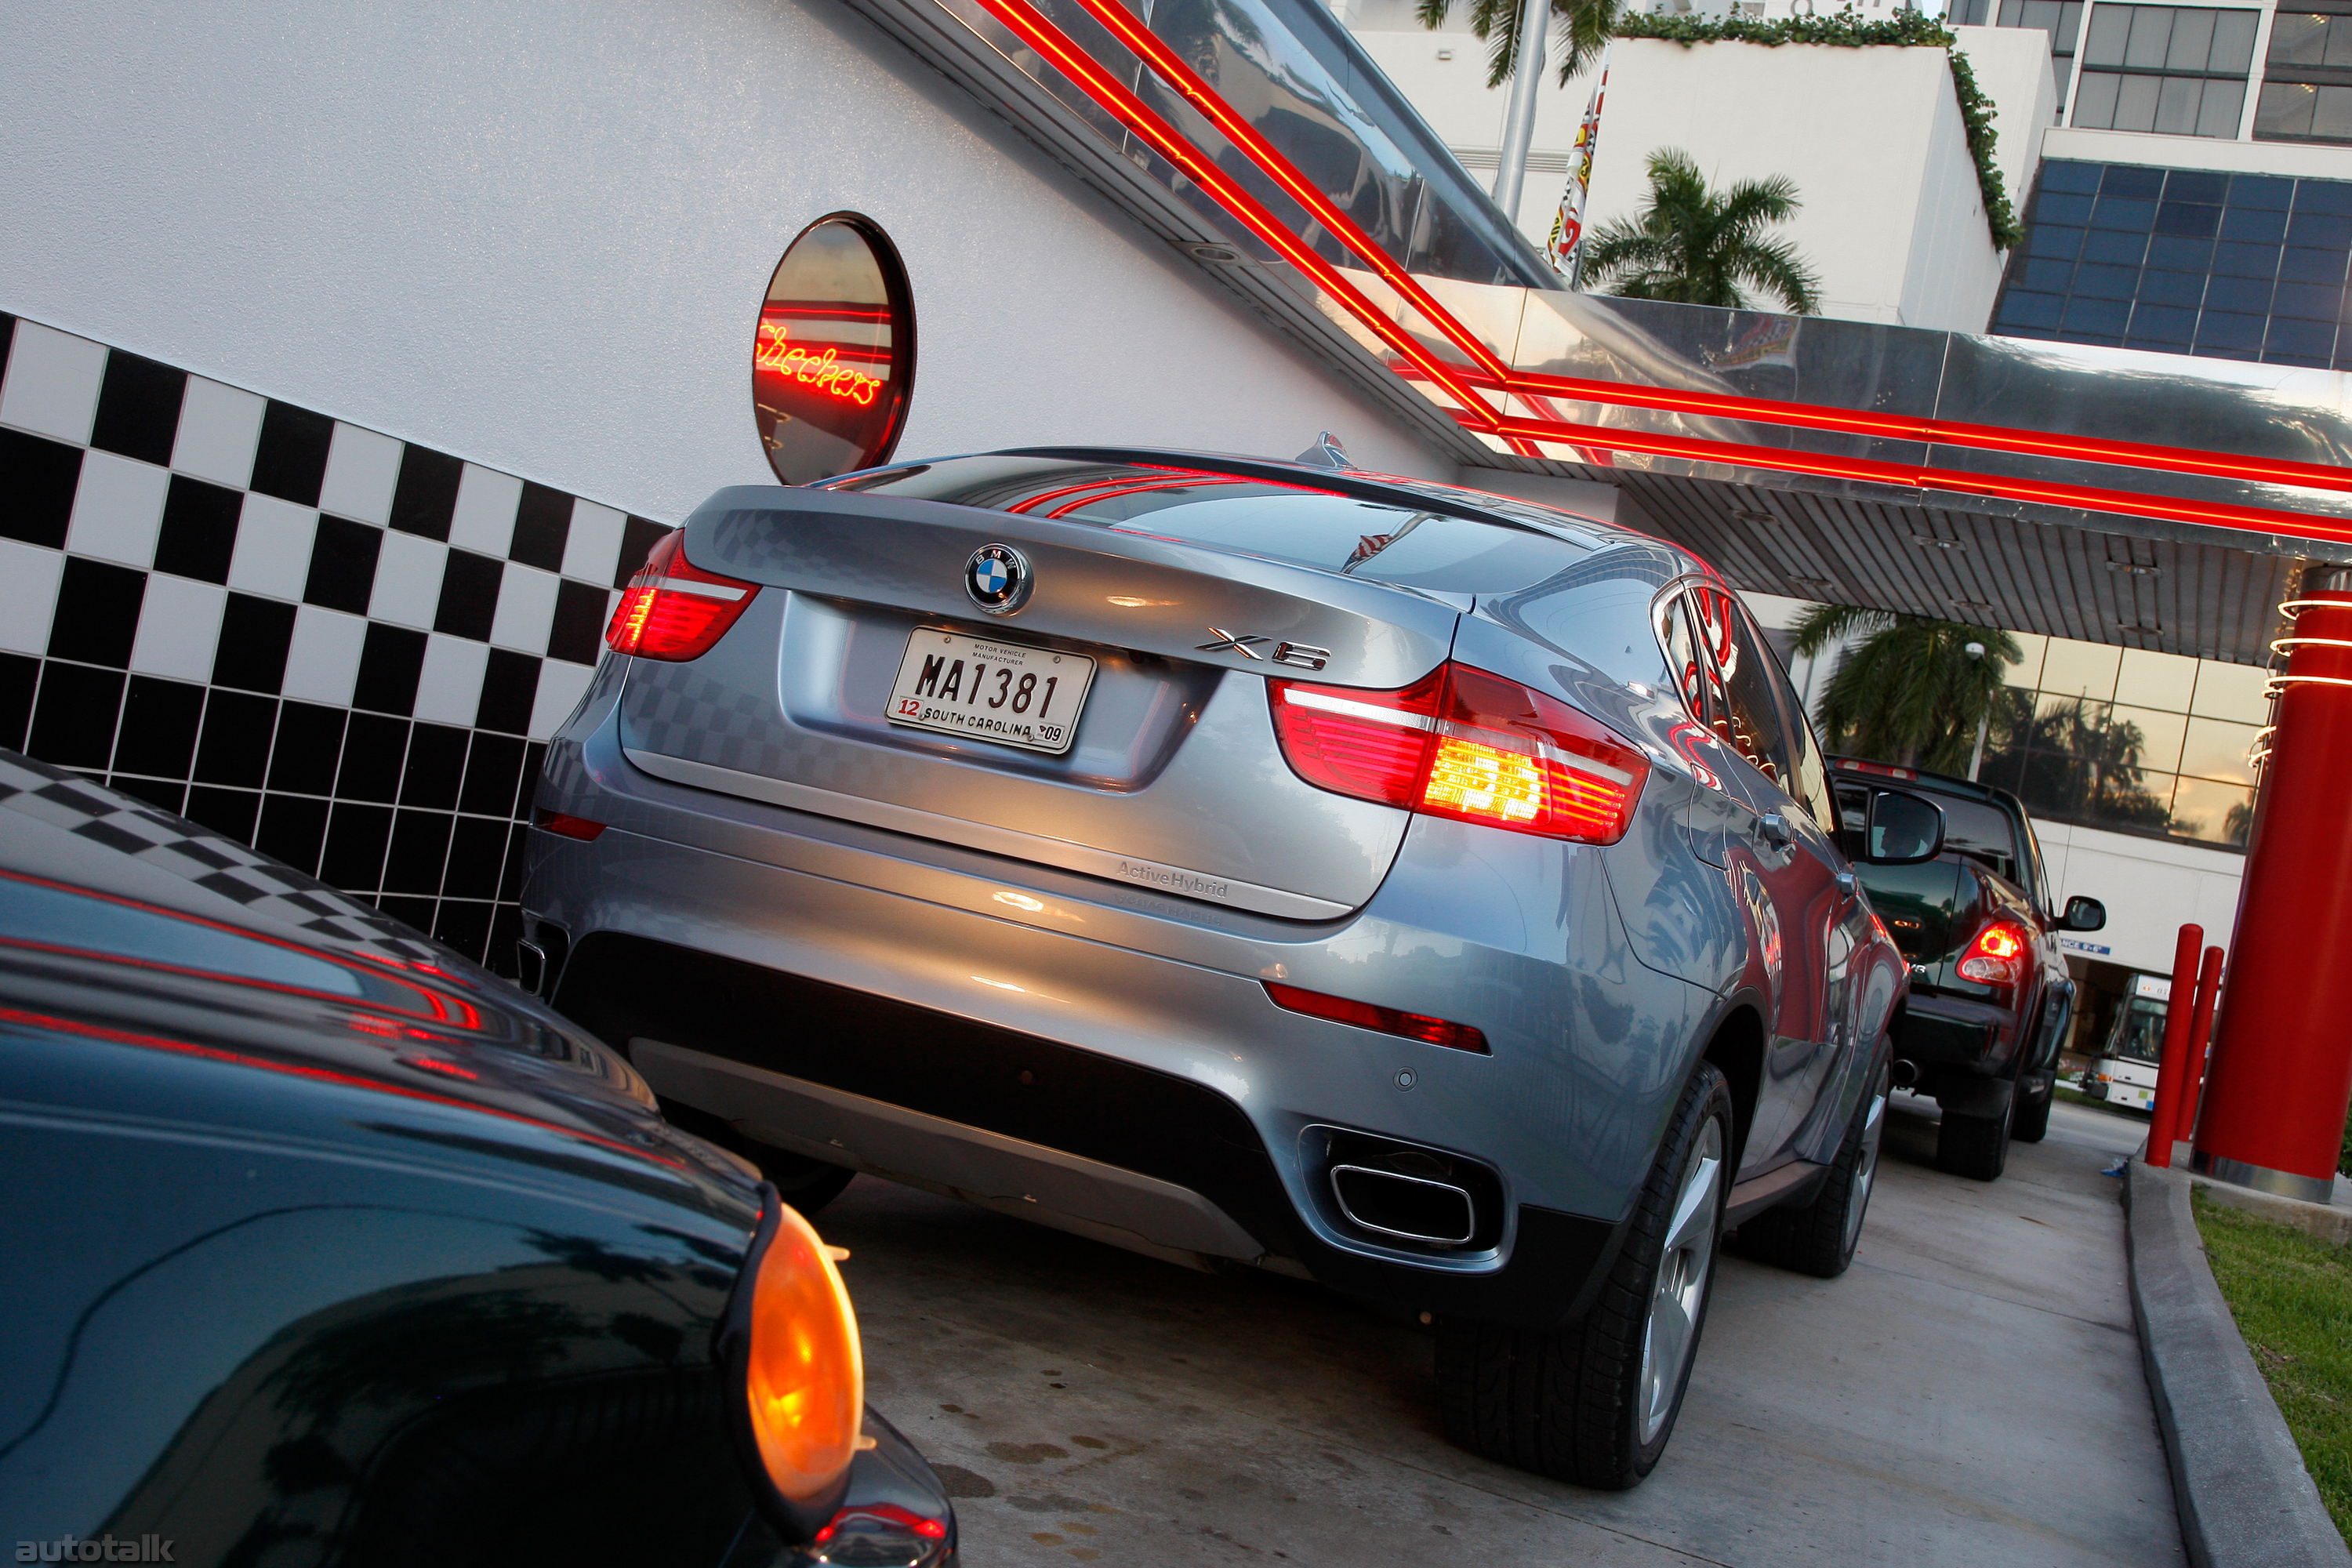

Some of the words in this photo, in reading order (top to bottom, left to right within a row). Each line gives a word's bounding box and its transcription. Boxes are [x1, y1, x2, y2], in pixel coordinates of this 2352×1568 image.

[975, 550, 1016, 570] BMW
[972, 652, 1023, 666] MANUFACTURER
[975, 644, 998, 653] MOTOR
[1000, 648, 1026, 658] VEHICLE
[1194, 626, 1332, 672] X6
[915, 654, 1059, 719] MA1381
[898, 699, 920, 717] 12
[924, 707, 965, 725] SOUTH
[967, 716, 1031, 736] CAROLINA
[1044, 726, 1062, 742] 09
[1117, 862, 1228, 898] ActiveHybrid
